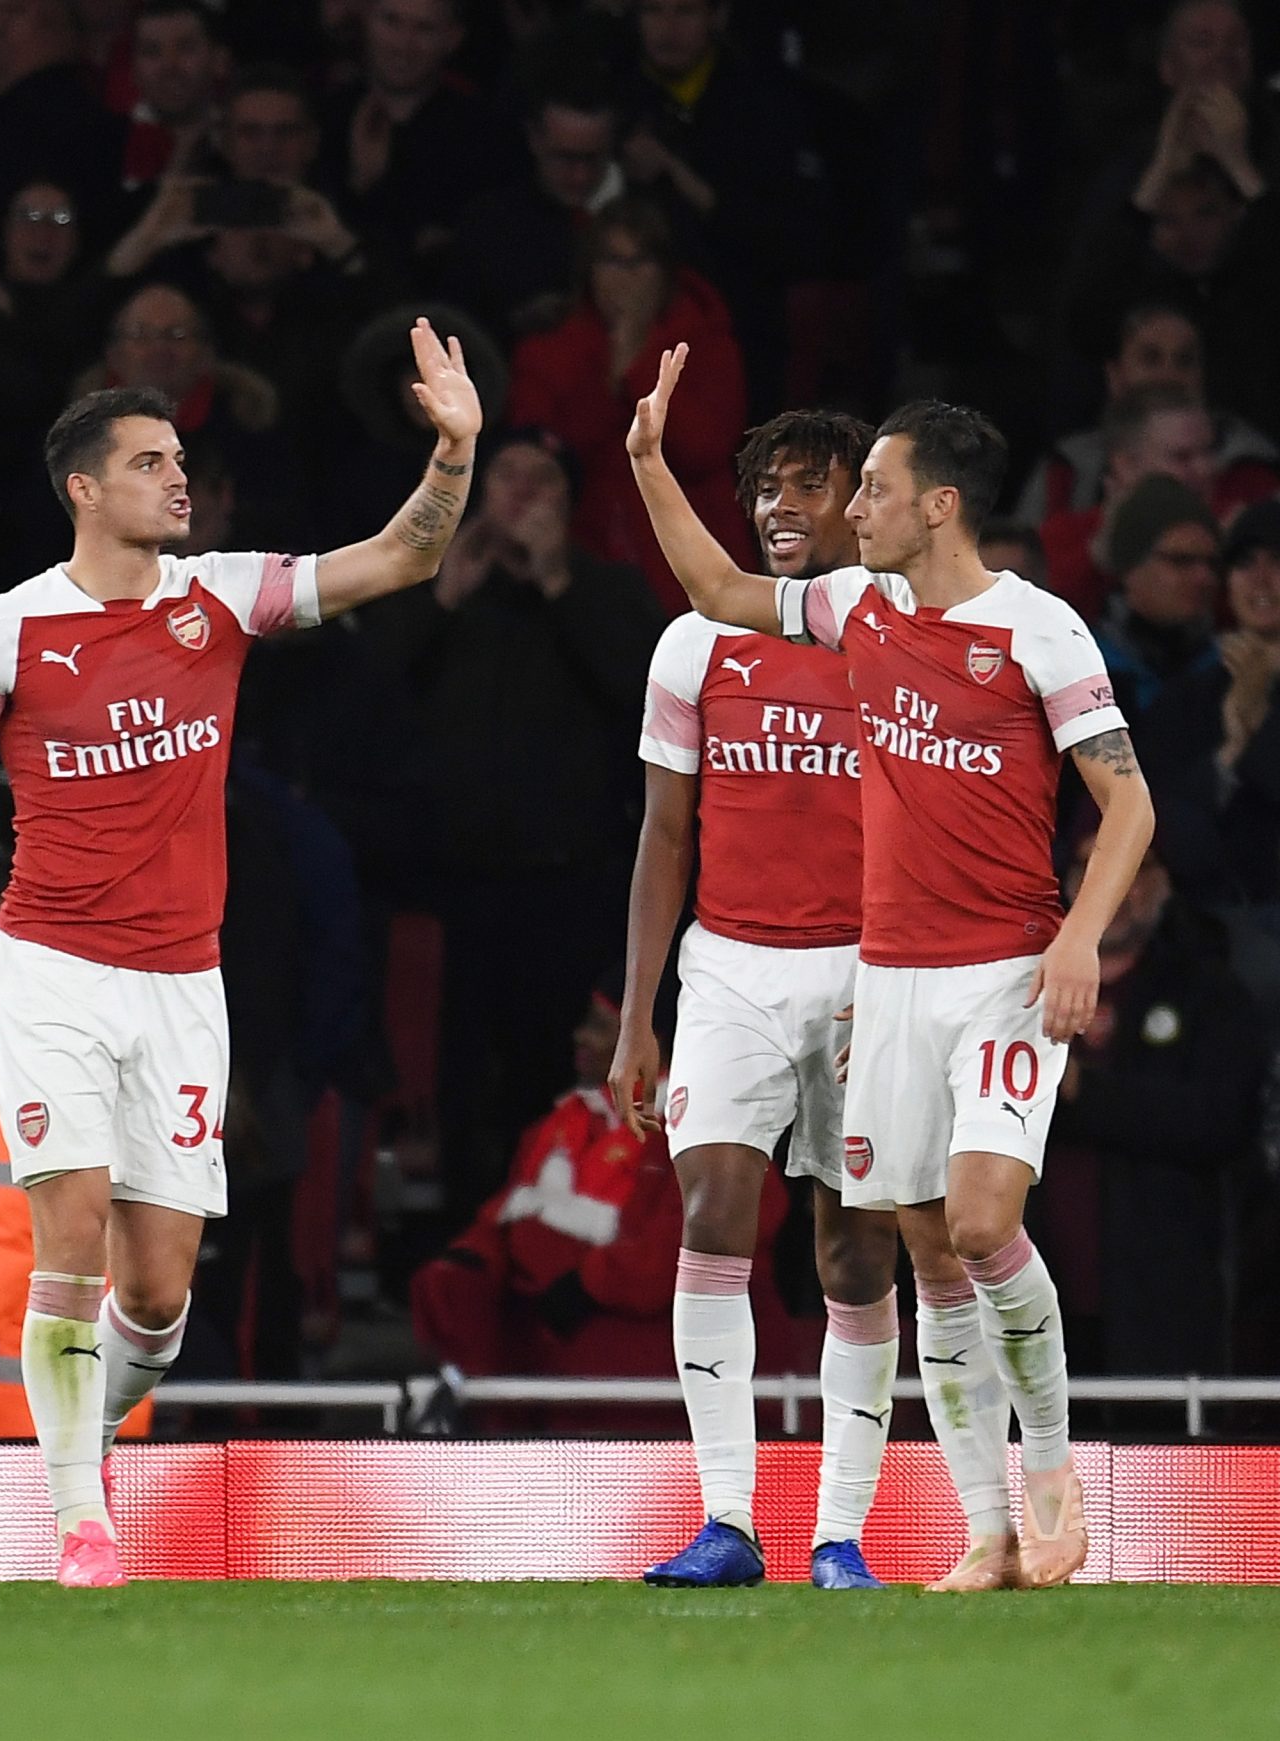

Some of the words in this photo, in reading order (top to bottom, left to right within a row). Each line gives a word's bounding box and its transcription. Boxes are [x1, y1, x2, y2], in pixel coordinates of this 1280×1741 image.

[107, 697, 165, 732] Fly
[761, 705, 824, 740] Fly
[894, 685, 940, 730] Fly
[44, 715, 221, 778] Emirates
[706, 724, 863, 779] Emirate
[859, 702, 1003, 776] Emirates
[978, 1039, 1039, 1101] 10
